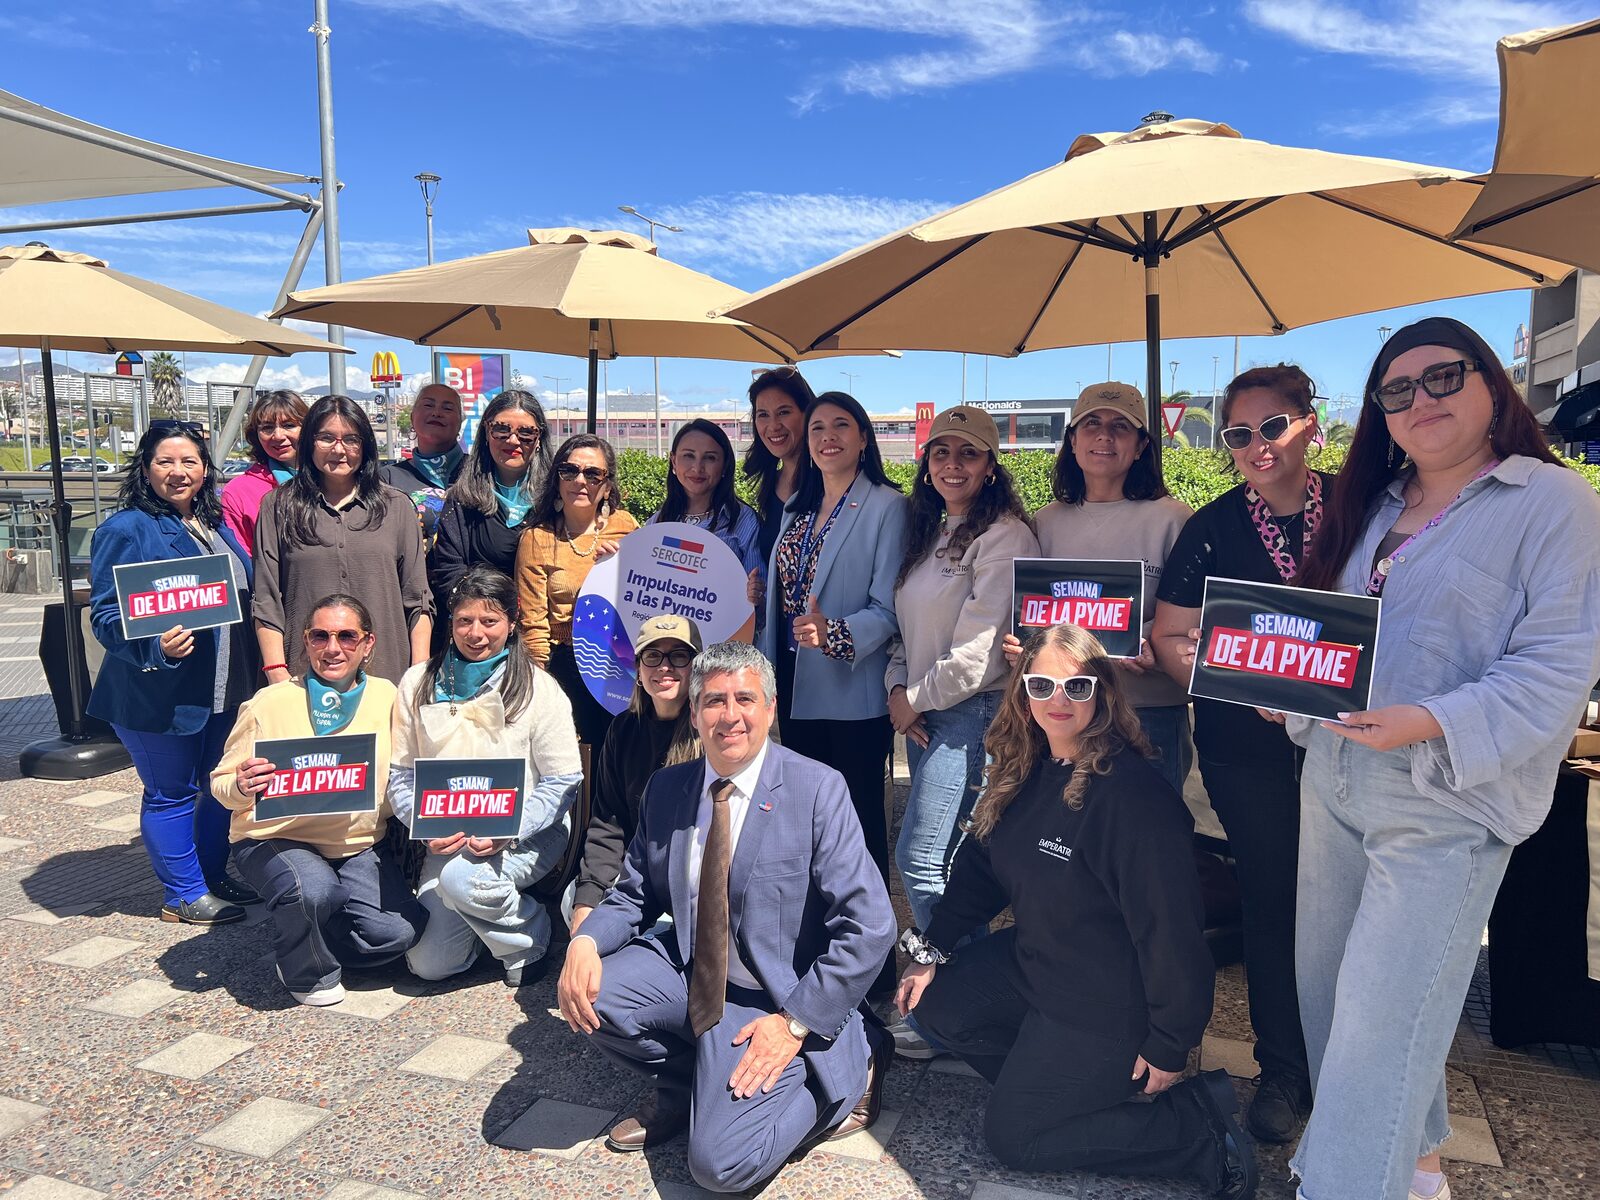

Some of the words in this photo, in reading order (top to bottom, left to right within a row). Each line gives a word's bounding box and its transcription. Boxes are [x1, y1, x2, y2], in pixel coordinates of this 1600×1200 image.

[444, 367, 473, 391] BI
[968, 401, 1022, 410] McDonald's
[651, 546, 708, 570] SERCOTEC
[154, 575, 197, 591] SEMANA
[626, 569, 718, 604] Impulsando
[1053, 581, 1098, 599] SEMANA
[133, 595, 156, 616] DE
[158, 592, 177, 613] LA
[179, 586, 223, 610] PYME
[623, 590, 634, 602] a
[636, 589, 659, 609] las
[661, 596, 713, 622] Pymes
[631, 610, 653, 621] Regió
[1025, 600, 1050, 624] DE
[1050, 601, 1071, 625] LA
[1074, 602, 1126, 628] PYME
[1254, 614, 1317, 642] SEMANA
[1213, 633, 1247, 667] DE
[1246, 638, 1277, 672] LA
[1278, 643, 1352, 684] PYME
[294, 753, 337, 770] SEMANA
[267, 773, 290, 796] DE
[292, 771, 312, 793] LA
[314, 767, 362, 791] PYME
[449, 777, 489, 792] SEMANA
[424, 794, 447, 815] DE
[447, 794, 465, 815] LA
[467, 793, 512, 815] PYME
